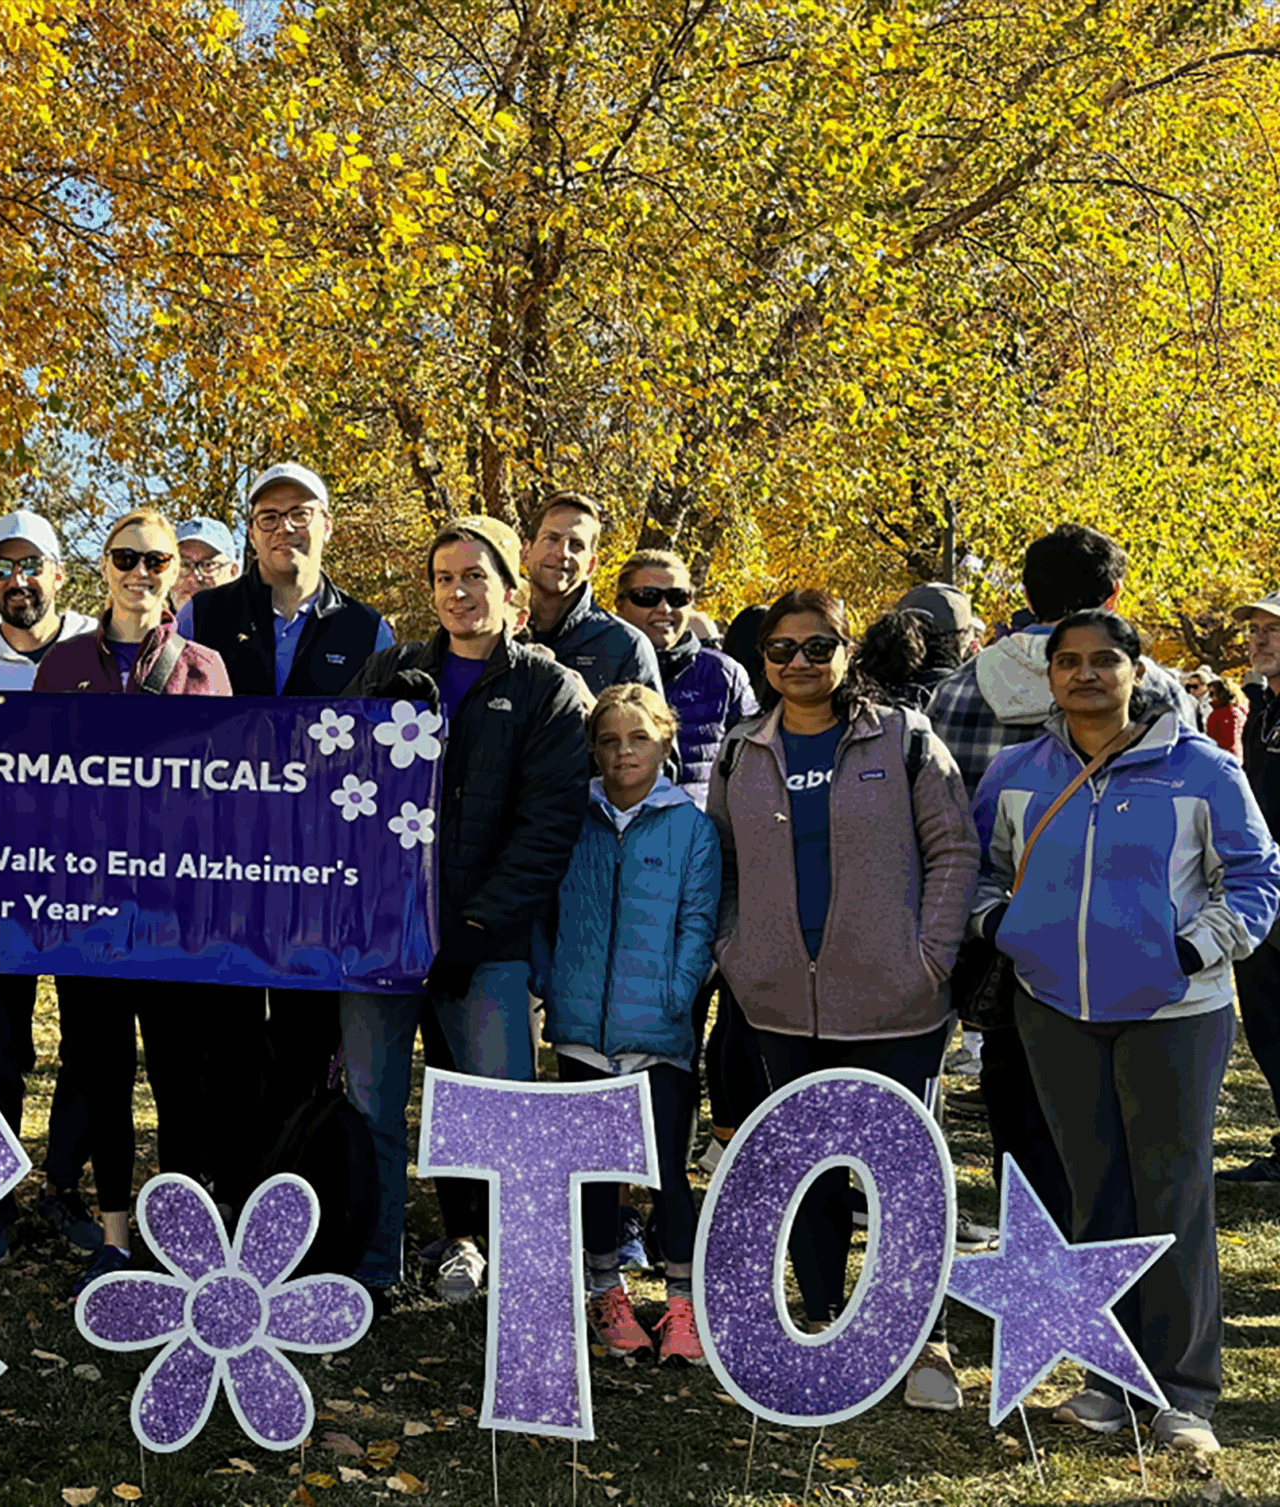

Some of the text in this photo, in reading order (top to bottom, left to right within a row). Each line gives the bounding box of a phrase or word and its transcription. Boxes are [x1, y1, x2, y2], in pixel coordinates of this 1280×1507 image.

[64, 852, 97, 874] to
[108, 850, 166, 877] End
[175, 853, 359, 886] Alzheimer's
[418, 1067, 957, 1441] TO
